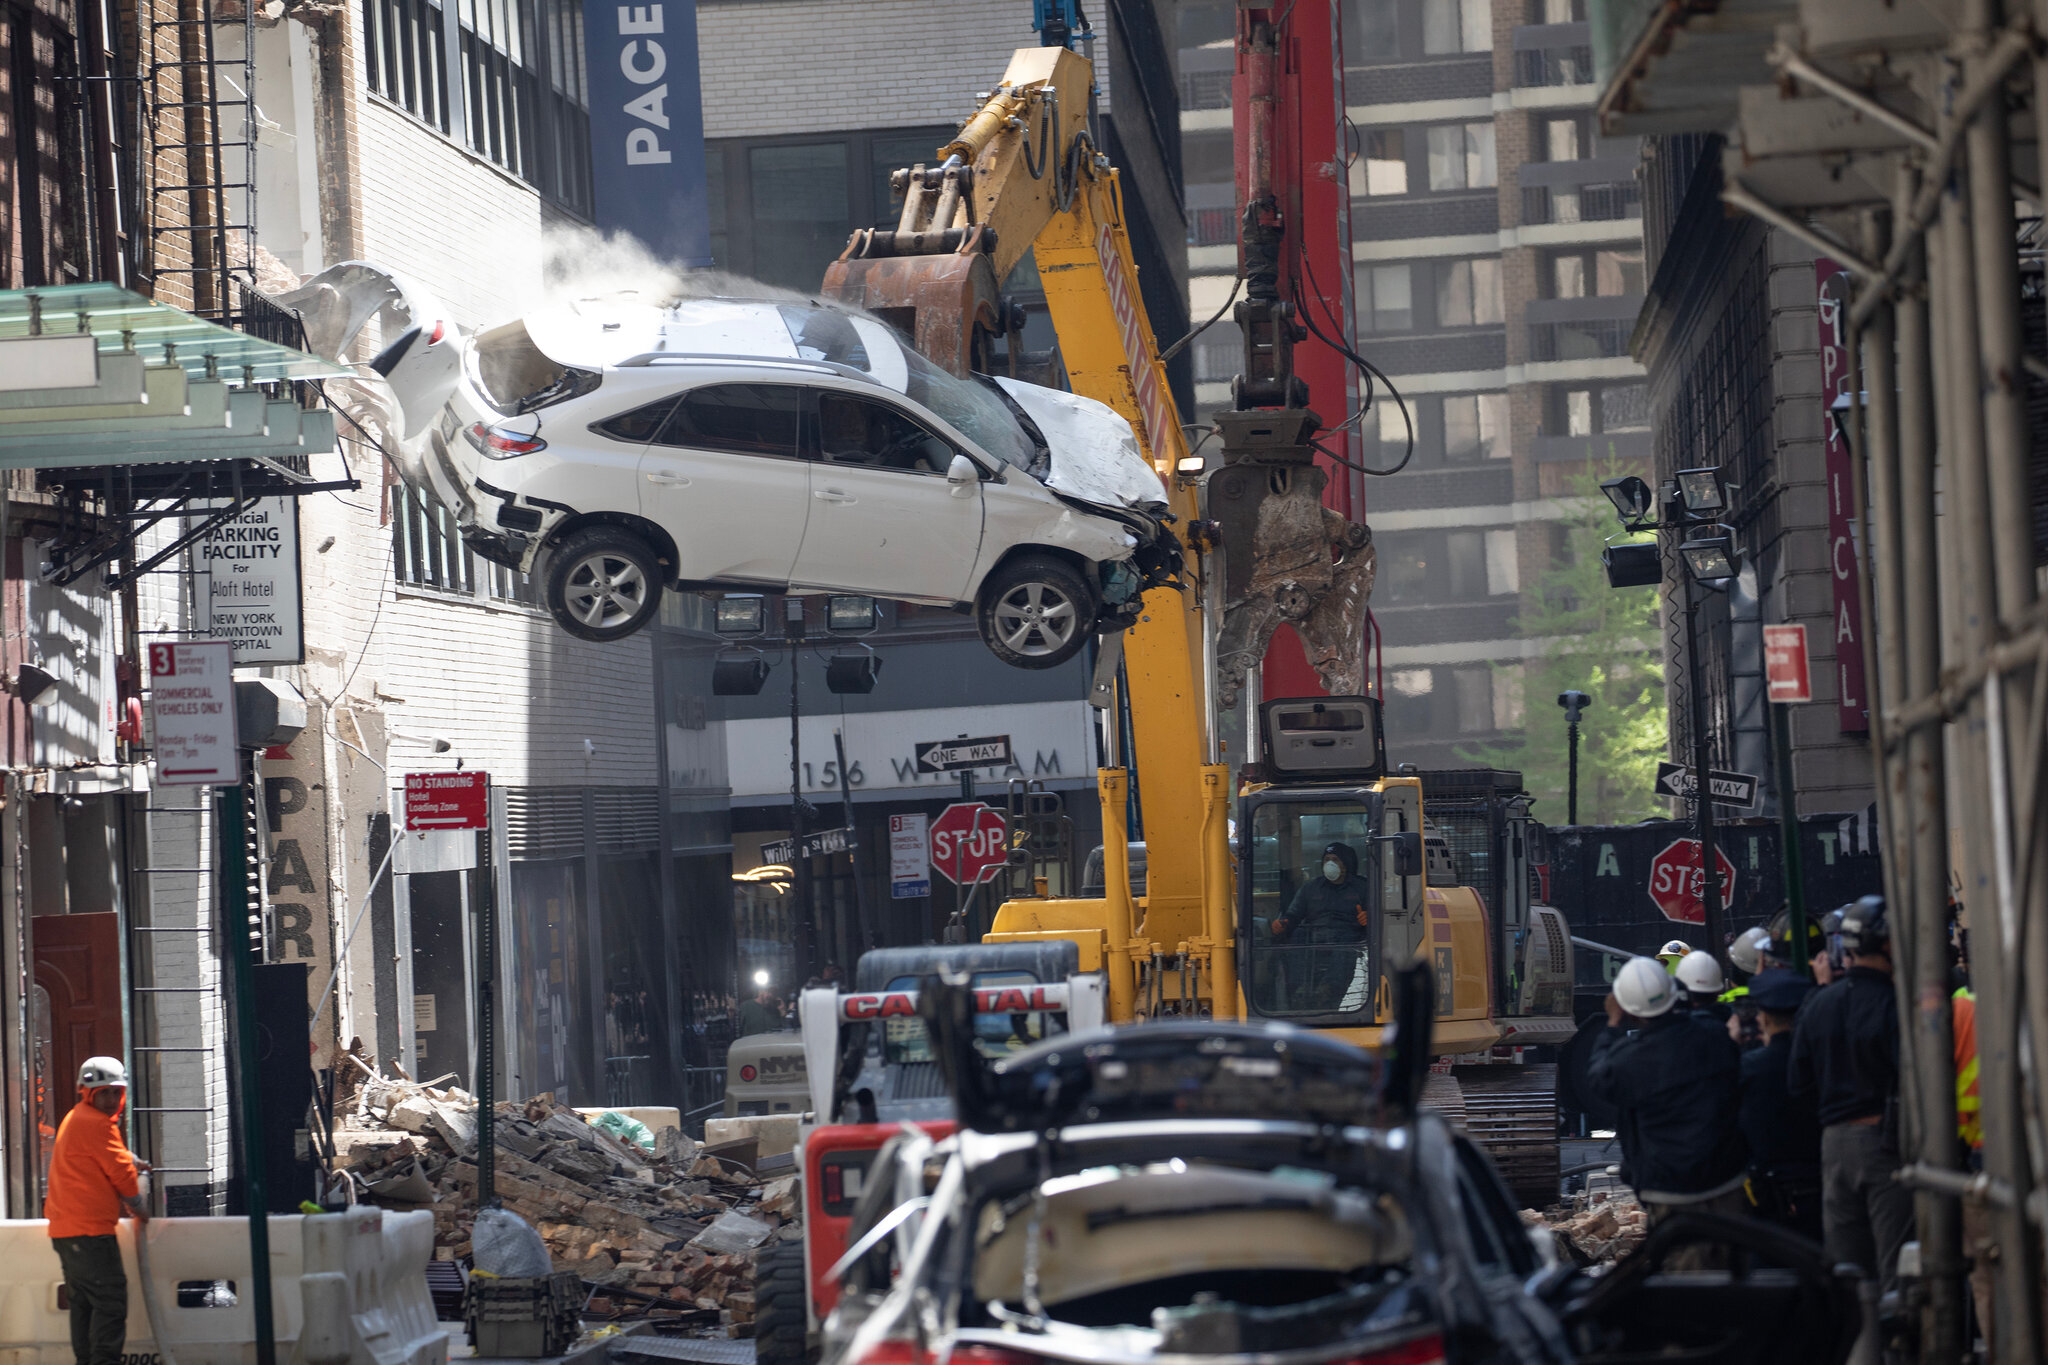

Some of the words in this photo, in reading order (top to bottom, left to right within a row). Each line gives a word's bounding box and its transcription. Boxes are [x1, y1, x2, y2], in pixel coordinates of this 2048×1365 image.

[617, 4, 672, 165] PACE
[203, 544, 282, 559] FACILITY
[232, 564, 250, 573] For
[212, 580, 238, 597] Aloft
[243, 581, 274, 596] Hotel
[212, 615, 237, 625] NEW
[241, 613, 275, 624] YORK
[210, 626, 282, 638] DOWNTOWN
[231, 639, 272, 650] SPITAL
[155, 646, 170, 674] 3
[155, 687, 213, 700] COMMERCIAL
[156, 702, 198, 715] VEHICLES
[201, 702, 224, 714] ONLY
[931, 750, 958, 763] ONE
[970, 745, 999, 759] WAY
[803, 759, 864, 787] 156
[408, 778, 423, 789] NO
[425, 776, 474, 789] STANDING
[1713, 783, 1743, 796] WAY
[408, 792, 429, 801] Hotel
[408, 803, 438, 813] Loading
[440, 802, 459, 811] Zone
[893, 817, 901, 831] 3
[935, 827, 1004, 860] STOP
[845, 986, 1061, 1020] CATAL
[760, 1055, 807, 1074] NYC
